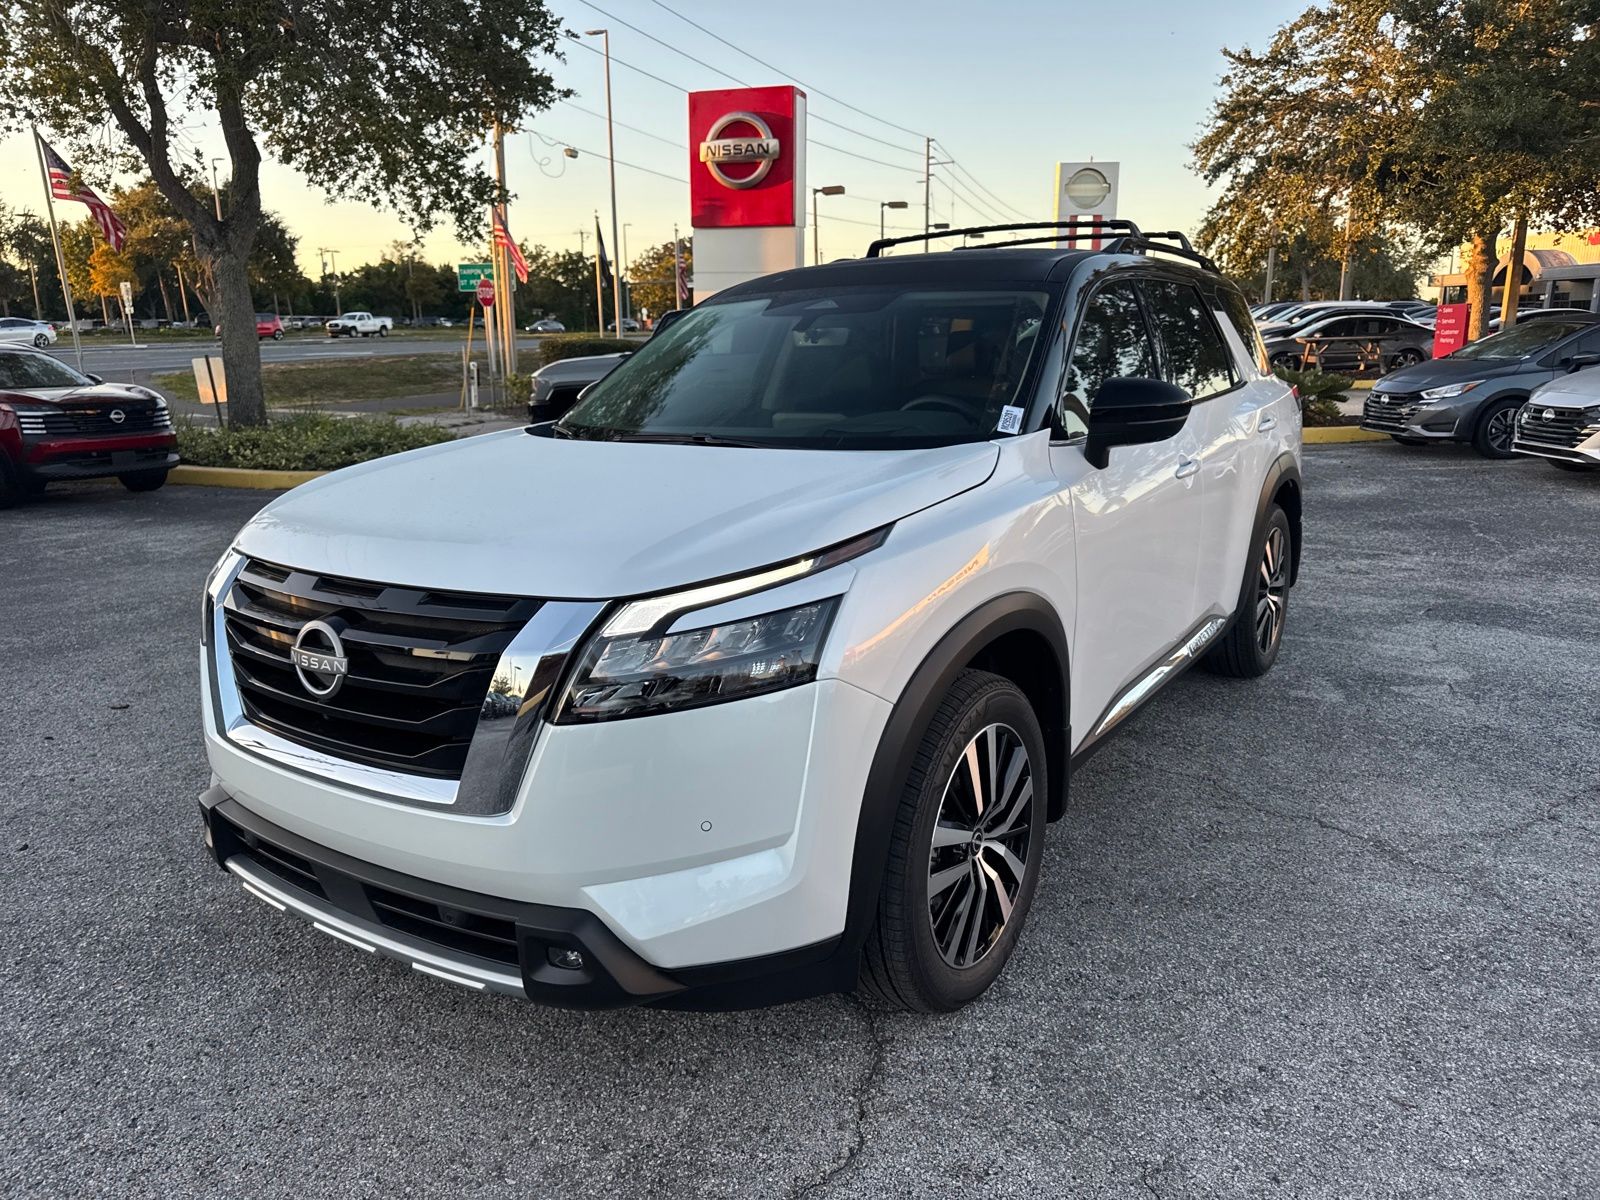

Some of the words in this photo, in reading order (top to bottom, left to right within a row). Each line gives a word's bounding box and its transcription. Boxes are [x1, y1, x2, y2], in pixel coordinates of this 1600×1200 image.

[706, 143, 769, 157] NISSAN
[479, 288, 494, 298] STOP
[291, 649, 345, 672] NISSAN
